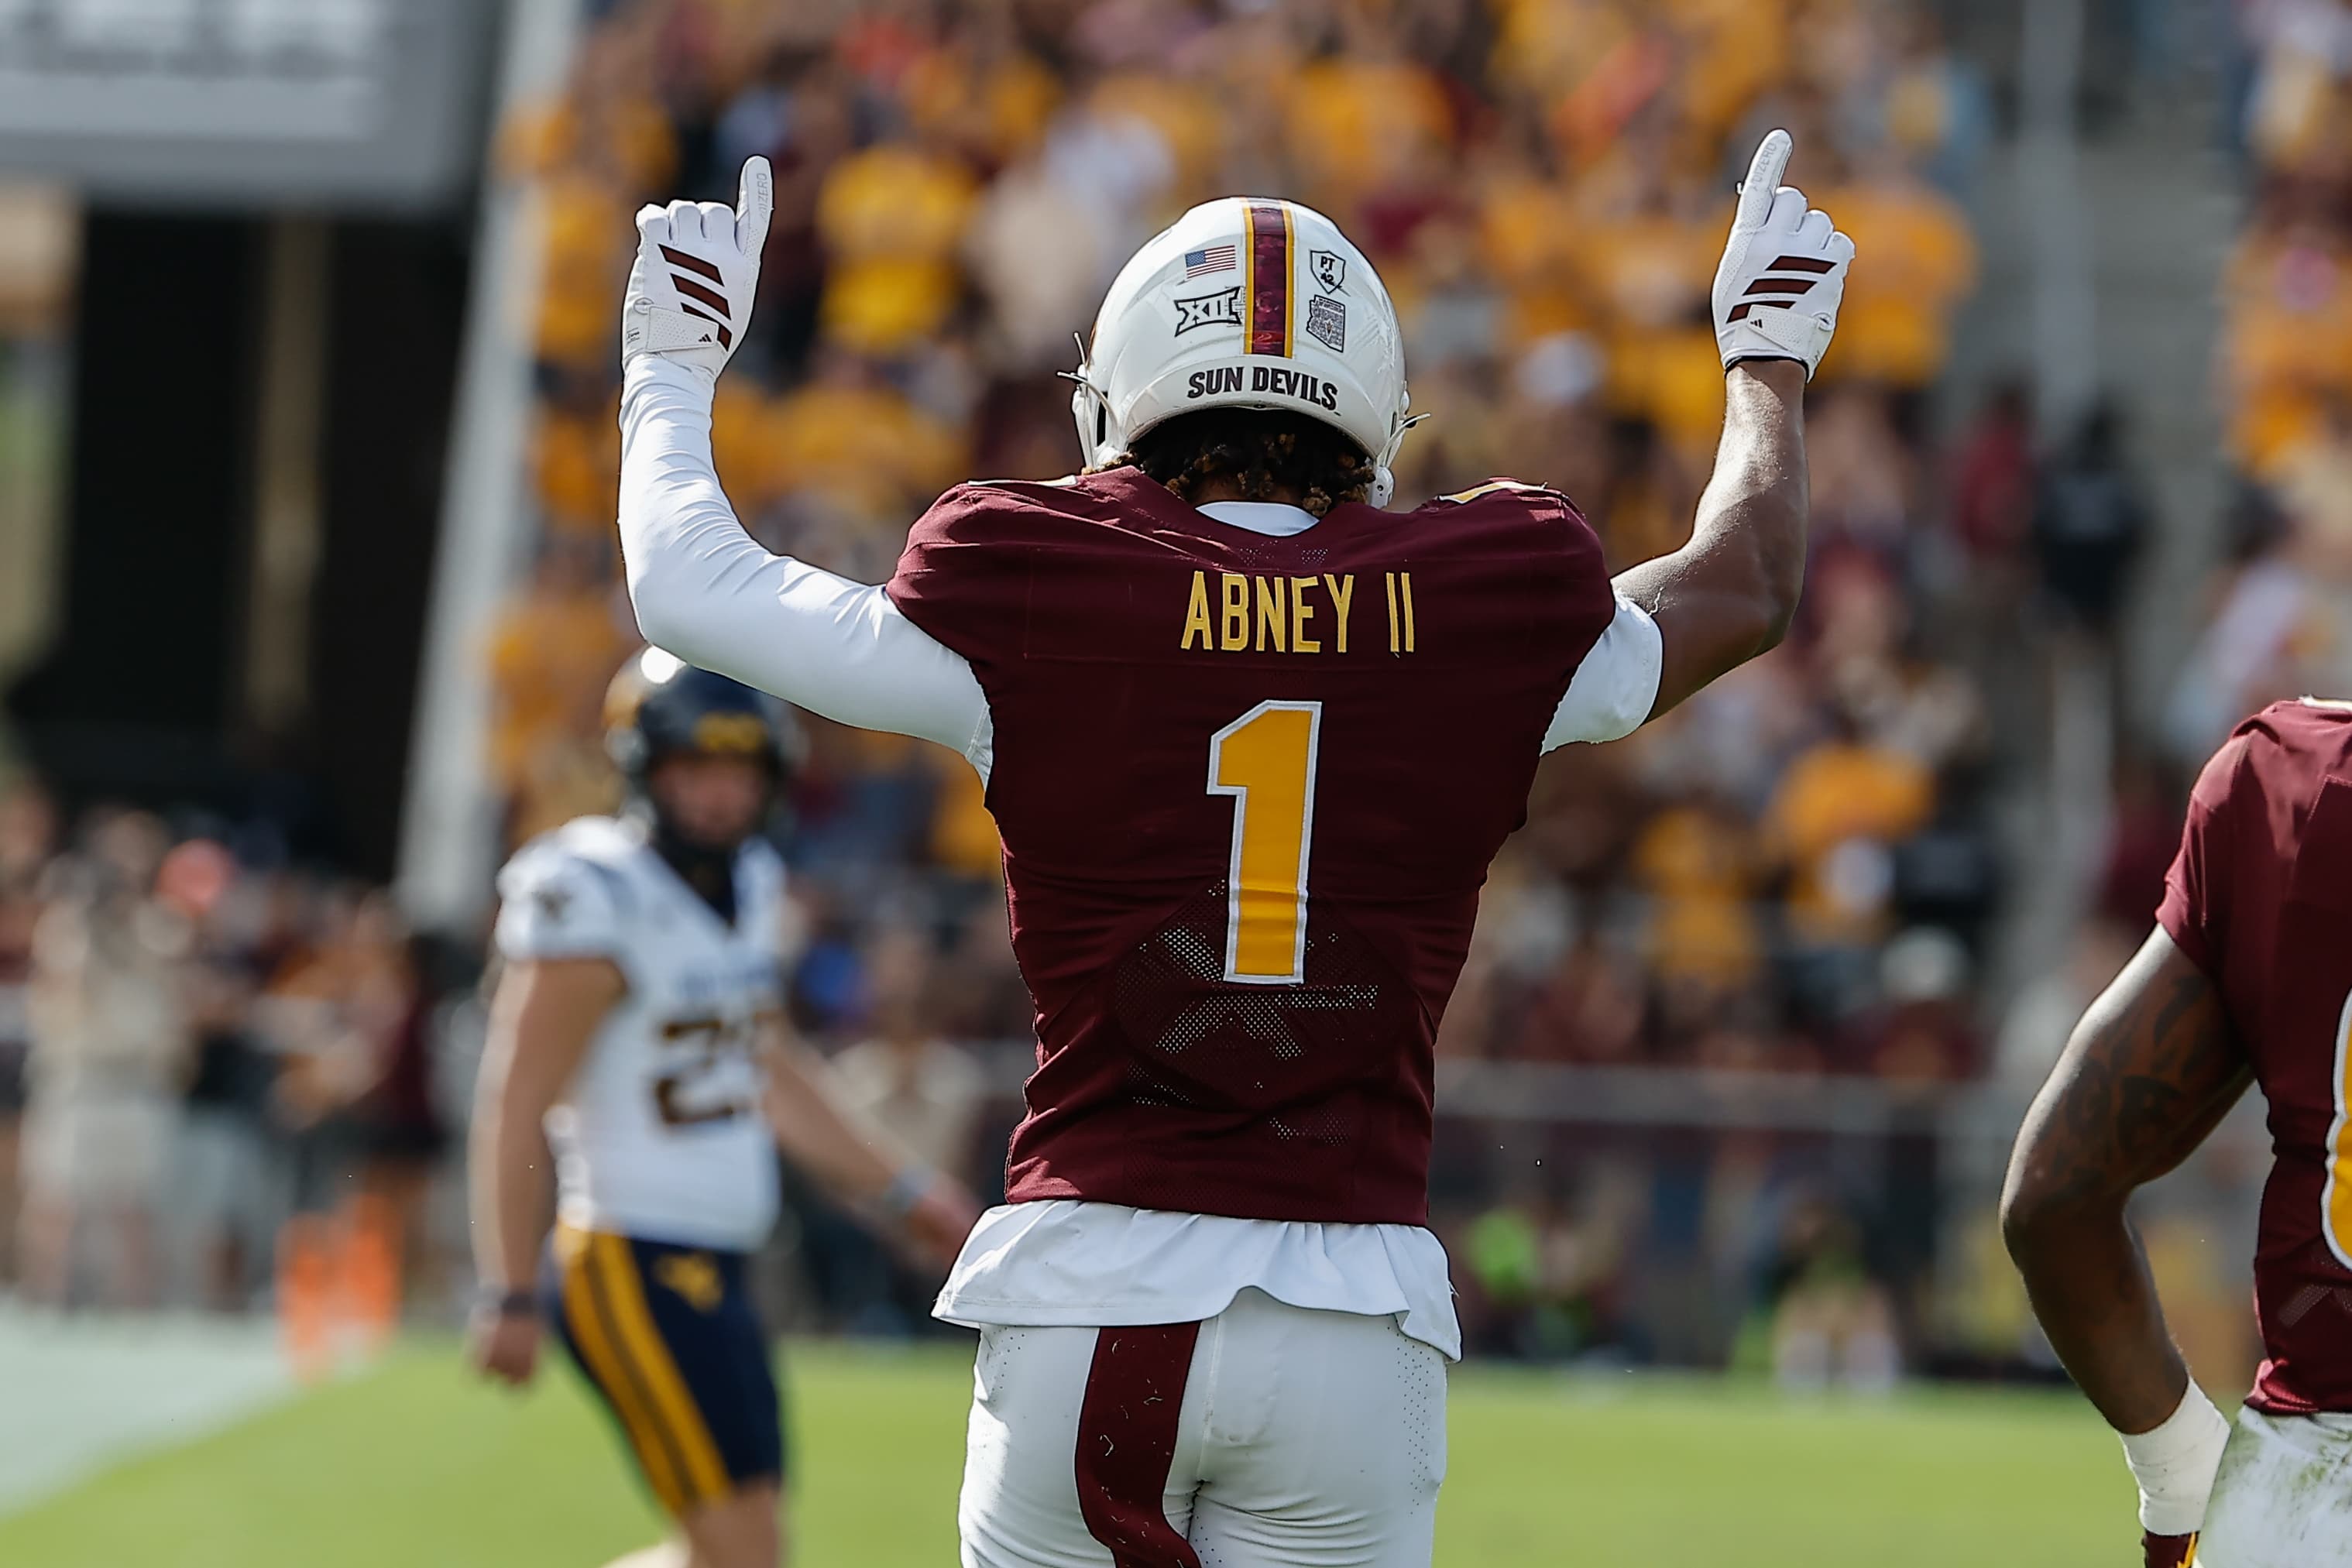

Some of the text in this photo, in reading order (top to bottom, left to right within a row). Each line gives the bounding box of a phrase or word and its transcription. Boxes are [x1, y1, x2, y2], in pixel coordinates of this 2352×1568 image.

[1187, 366, 1338, 411] SUN DEVILS
[1180, 570, 1415, 654] ABNEY II
[1207, 699, 1322, 984] 1
